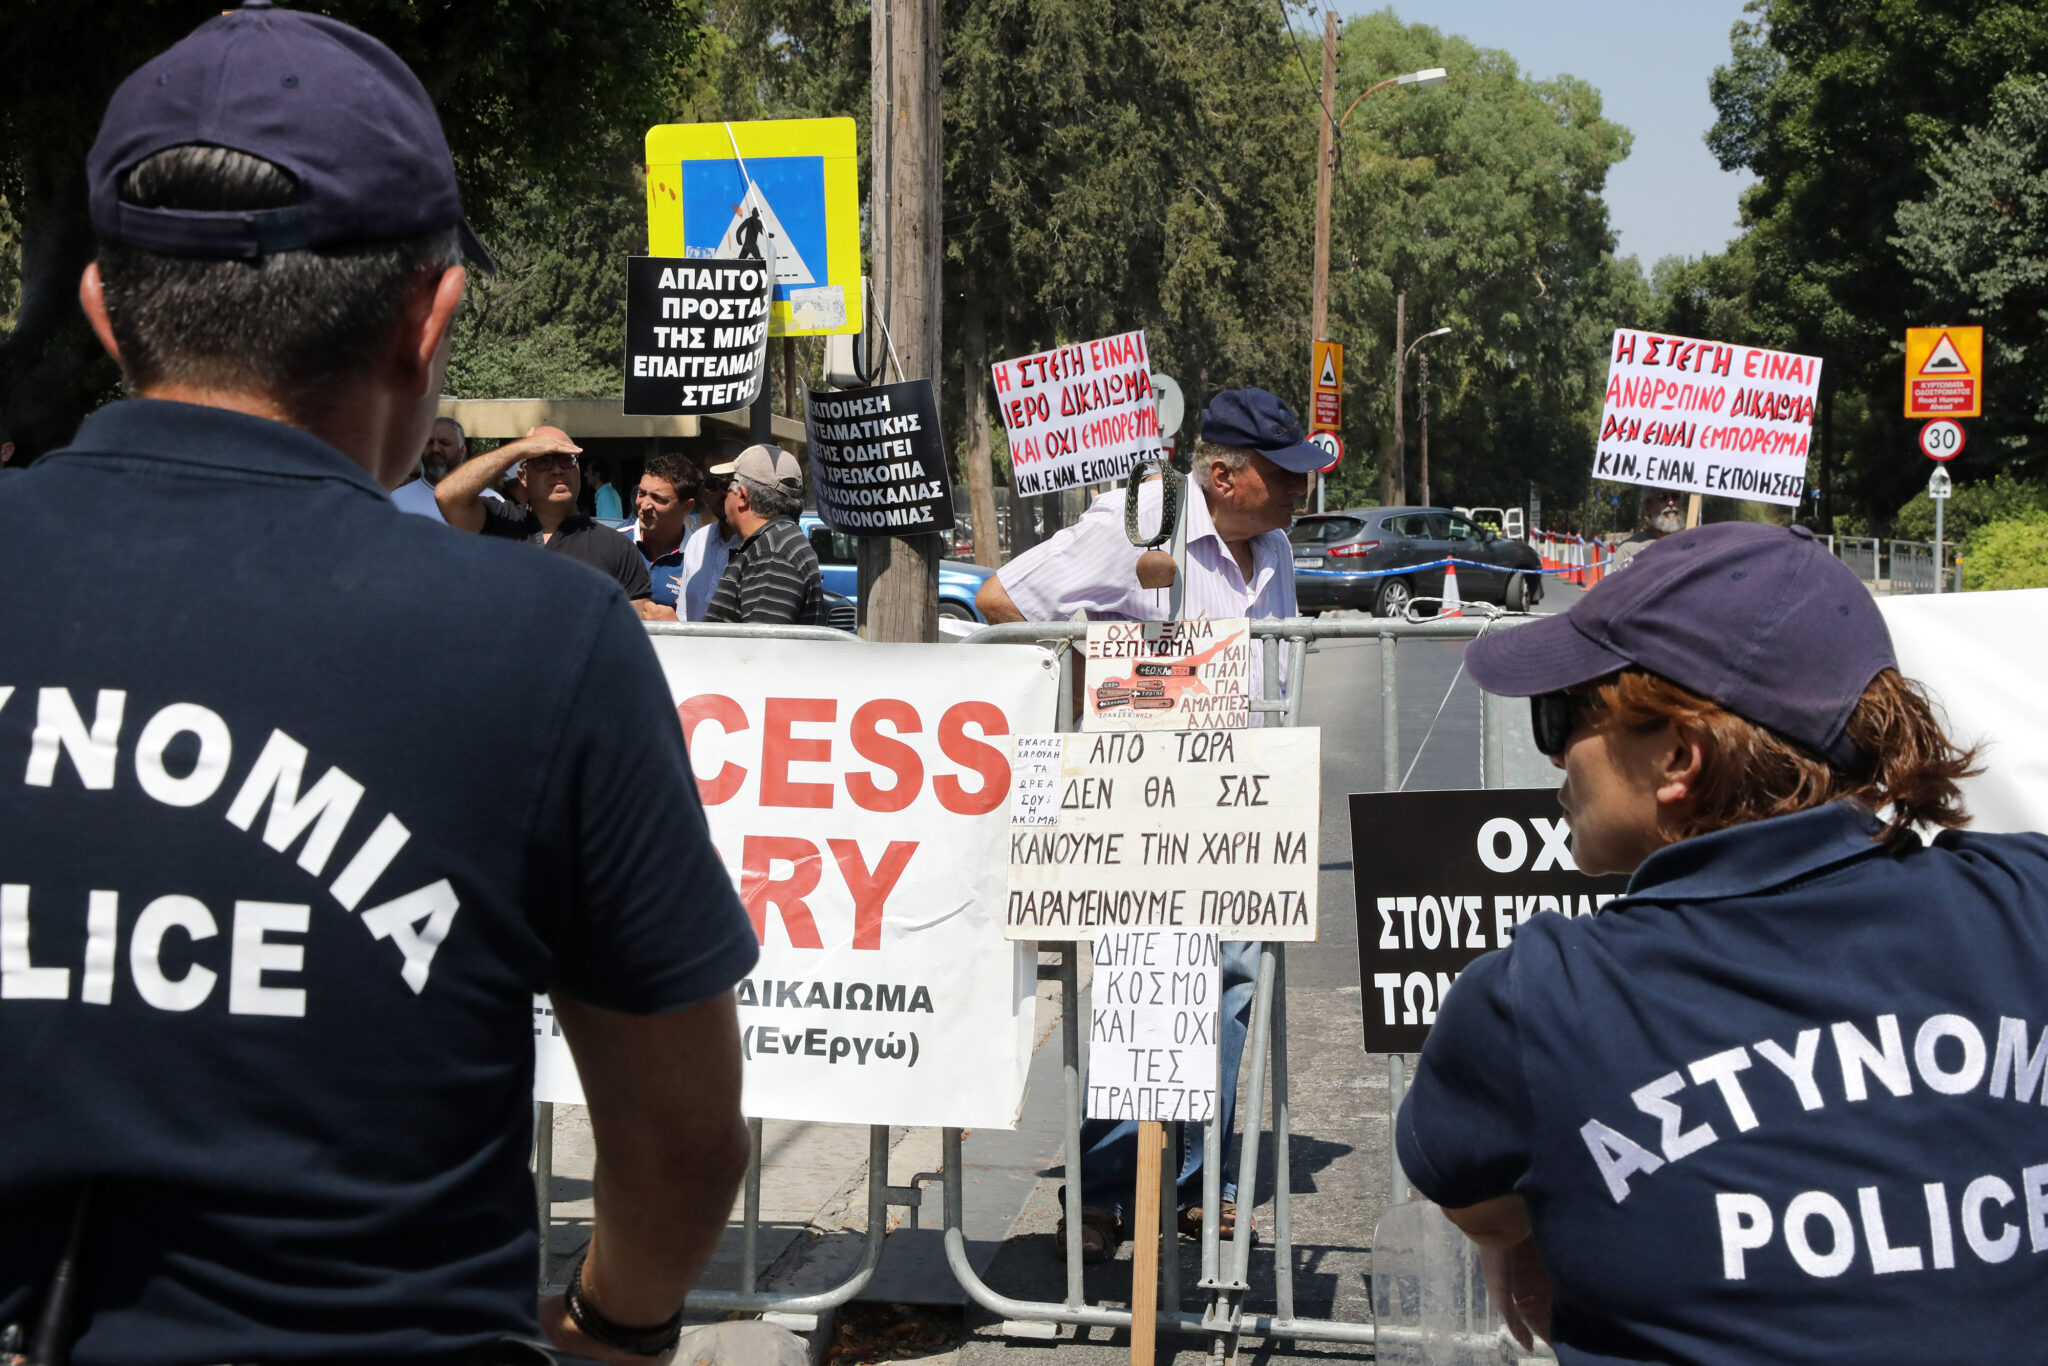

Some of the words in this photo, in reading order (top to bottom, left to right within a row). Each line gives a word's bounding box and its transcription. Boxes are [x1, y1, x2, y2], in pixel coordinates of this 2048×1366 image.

[653, 326, 705, 348] ΤΗΣ
[714, 319, 768, 348] ΜΙΚΡ
[994, 364, 1011, 394] Η
[1017, 346, 1085, 389] ΣΤΕΓΗ
[1089, 333, 1144, 371] ΕΙΝΑΙ
[1616, 334, 1635, 364] Η
[1642, 336, 1733, 376] ΣΤΕΓΗ
[1744, 350, 1815, 386] ΕΙΝΑΙ
[681, 375, 757, 406] ΣΤΕΓΗΣ
[1003, 392, 1050, 429] ΙΕΡΟ
[1060, 368, 1153, 417] ΔΙΚΑΙΩΜΑ
[1605, 373, 1726, 414] ΑΝΘΡΩΠΙΝΟ
[1730, 387, 1814, 426] ΔΙΚΑΙΩΜΑ
[843, 438, 913, 462] ΟΔΗΓΕΙ
[1011, 436, 1042, 467] ΚΑΙ
[1045, 426, 1078, 459] ΟΧΙ
[1081, 405, 1161, 449] ΕΜΠΟΡΕΥΜΑ
[1601, 414, 1641, 442] ΔΕΝ
[1643, 420, 1697, 448] ΕΙΝΑΙ
[1700, 424, 1808, 458] ΕΜΠΟΡΕΥΜΑ
[1929, 429, 1955, 449] 30
[827, 460, 926, 484] ΧΡΕΩΚΟΠΙΑ
[1706, 464, 1805, 497] ΕΚΠΟΙΗΣΕΙΣ
[831, 505, 935, 528] ΟΙΚΟΝΟΜΙΑΣ
[1223, 644, 1246, 661] ΚΑΙ
[1205, 661, 1247, 679] ΠΑΛΙ
[1215, 679, 1239, 695] ΓΙΑ
[1180, 695, 1248, 713] ΑΜΑΡΤΙΕΣ
[1089, 733, 1145, 764] ΑΠΟ
[1175, 732, 1235, 763] ΤΩΡΑ
[1033, 764, 1047, 773] ΤΑ
[1060, 777, 1113, 809] ΔΕΝ
[1144, 776, 1175, 808] ΘΑ
[1216, 775, 1270, 807] ΣΑΣ
[0, 686, 460, 995] ΝΟΜΙΑ
[1011, 832, 1124, 865] ΚΑΝΟΥΜΕ
[1141, 832, 1189, 865] ΤΗΝ
[1197, 831, 1261, 864] ΧΑΡΗ
[1274, 831, 1308, 864] ΝΑ
[1008, 890, 1187, 926] ΠΑΡΑΜΕΙΝΟΥΜΕ
[1200, 890, 1309, 925] ΠΡΟΒΑΤΑ
[1377, 895, 1486, 950] ΣΤΟΥΣ
[1095, 932, 1160, 966] ΔΗΤΕ
[1173, 932, 1219, 967] ΤΟΝ
[736, 979, 935, 1014] ΔΙΚΑΙΩΜΑ
[1107, 971, 1207, 1006] ΚΟΣΜΟ
[1092, 1009, 1134, 1043] ΚΑΙ
[1174, 1011, 1217, 1045] ΟΧΙ
[1128, 1049, 1184, 1083] ΤΕΣ
[1090, 1086, 1216, 1121] ΤΡΑΠΕΖΕΣ
